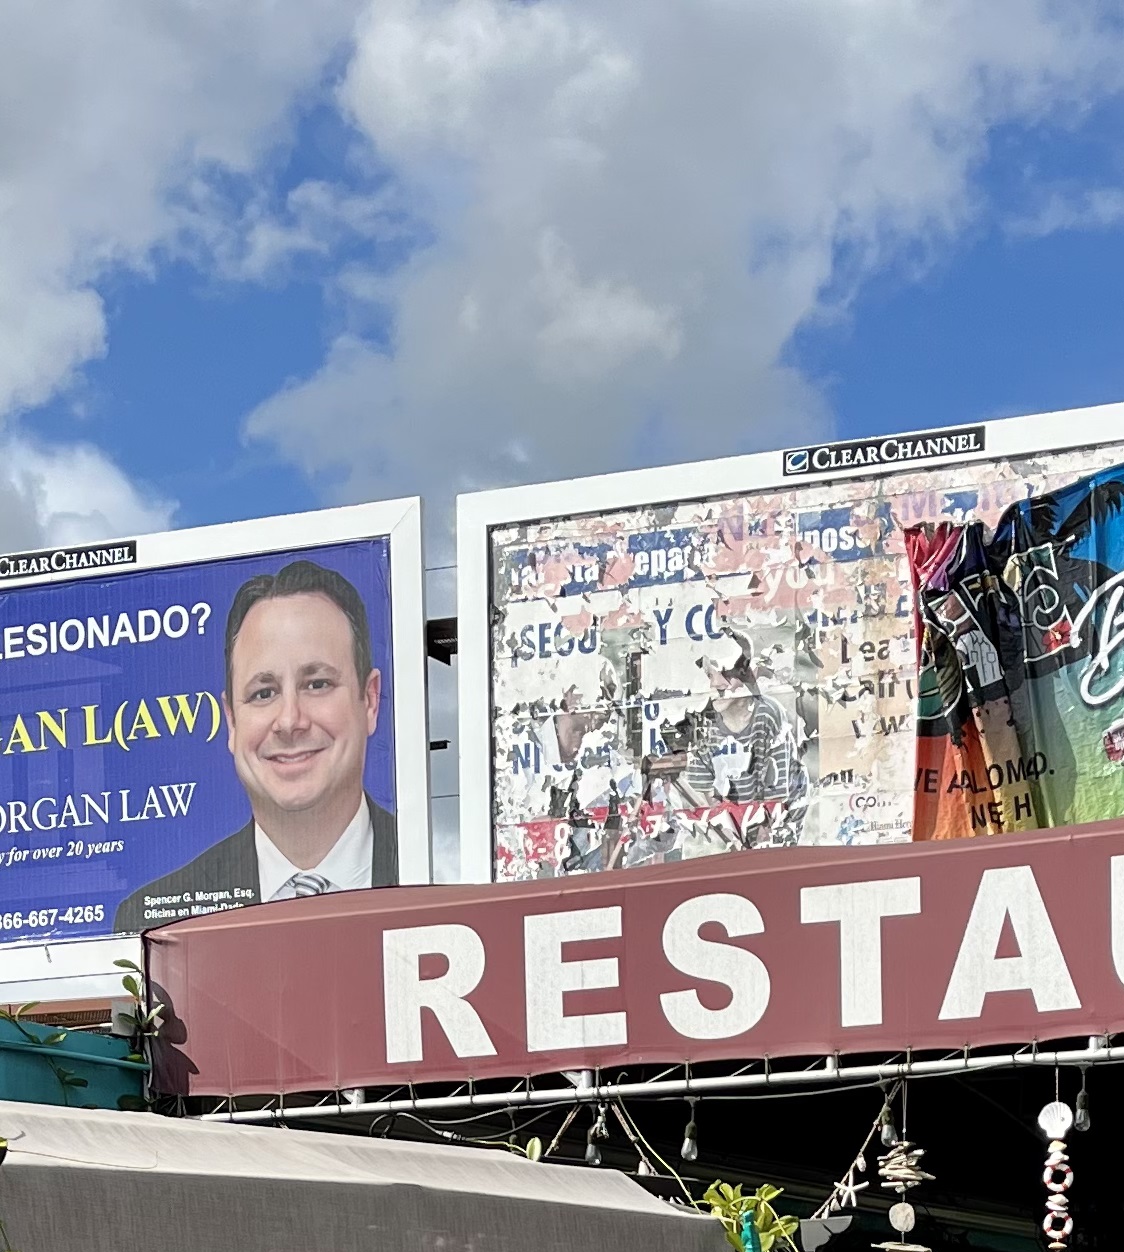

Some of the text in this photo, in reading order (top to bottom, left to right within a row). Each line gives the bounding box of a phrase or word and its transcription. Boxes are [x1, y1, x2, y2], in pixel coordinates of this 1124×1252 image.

[0, 602, 212, 660] ESIONADO?
[0, 691, 221, 754] AN L(AW)
[119, 783, 197, 822] LAW
[6, 846, 30, 867] for
[33, 845, 64, 860] over
[67, 840, 84, 857] 20
[87, 838, 125, 859] years
[144, 887, 255, 908] Spencer G. Morgan, Esq.
[144, 907, 176, 920] Oficina
[178, 907, 190, 917] en
